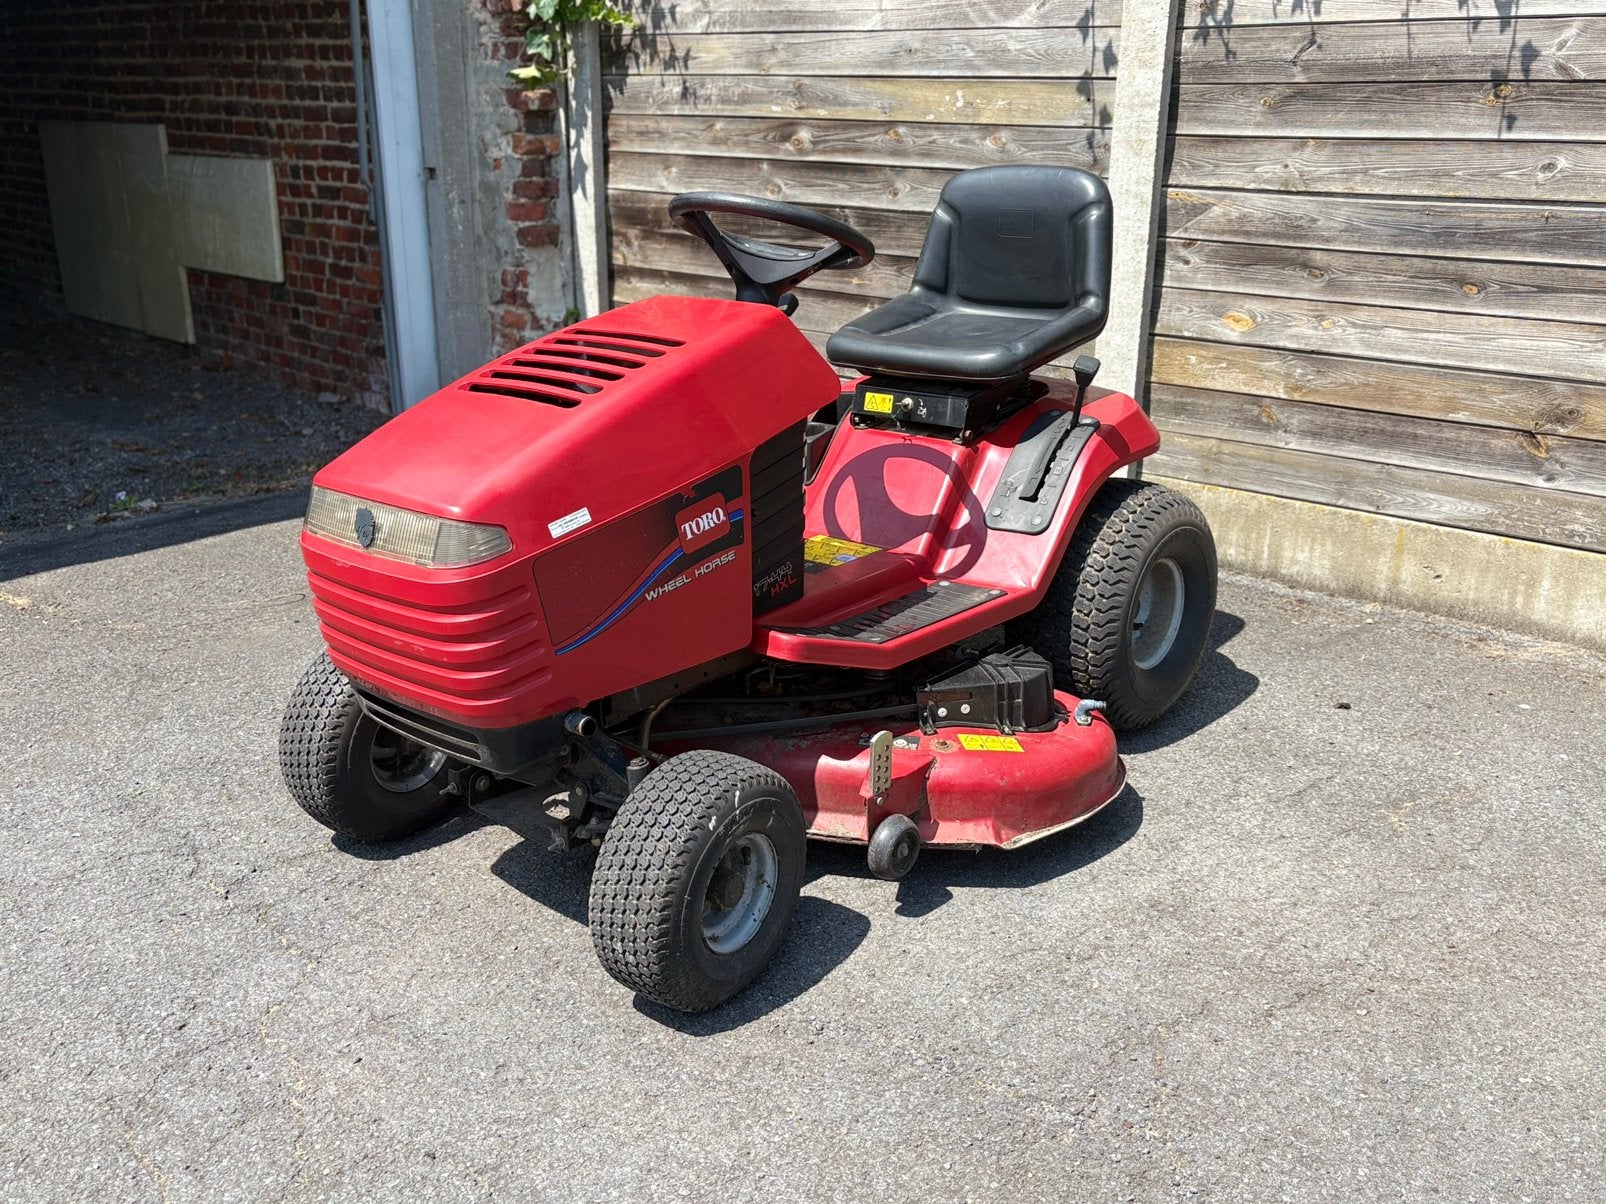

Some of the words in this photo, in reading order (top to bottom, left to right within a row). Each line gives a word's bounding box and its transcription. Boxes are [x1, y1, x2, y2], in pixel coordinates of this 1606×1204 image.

[681, 507, 725, 540] TORO
[645, 574, 692, 601] WHEEL
[694, 549, 737, 578] HORSE
[770, 574, 798, 597] HXL
